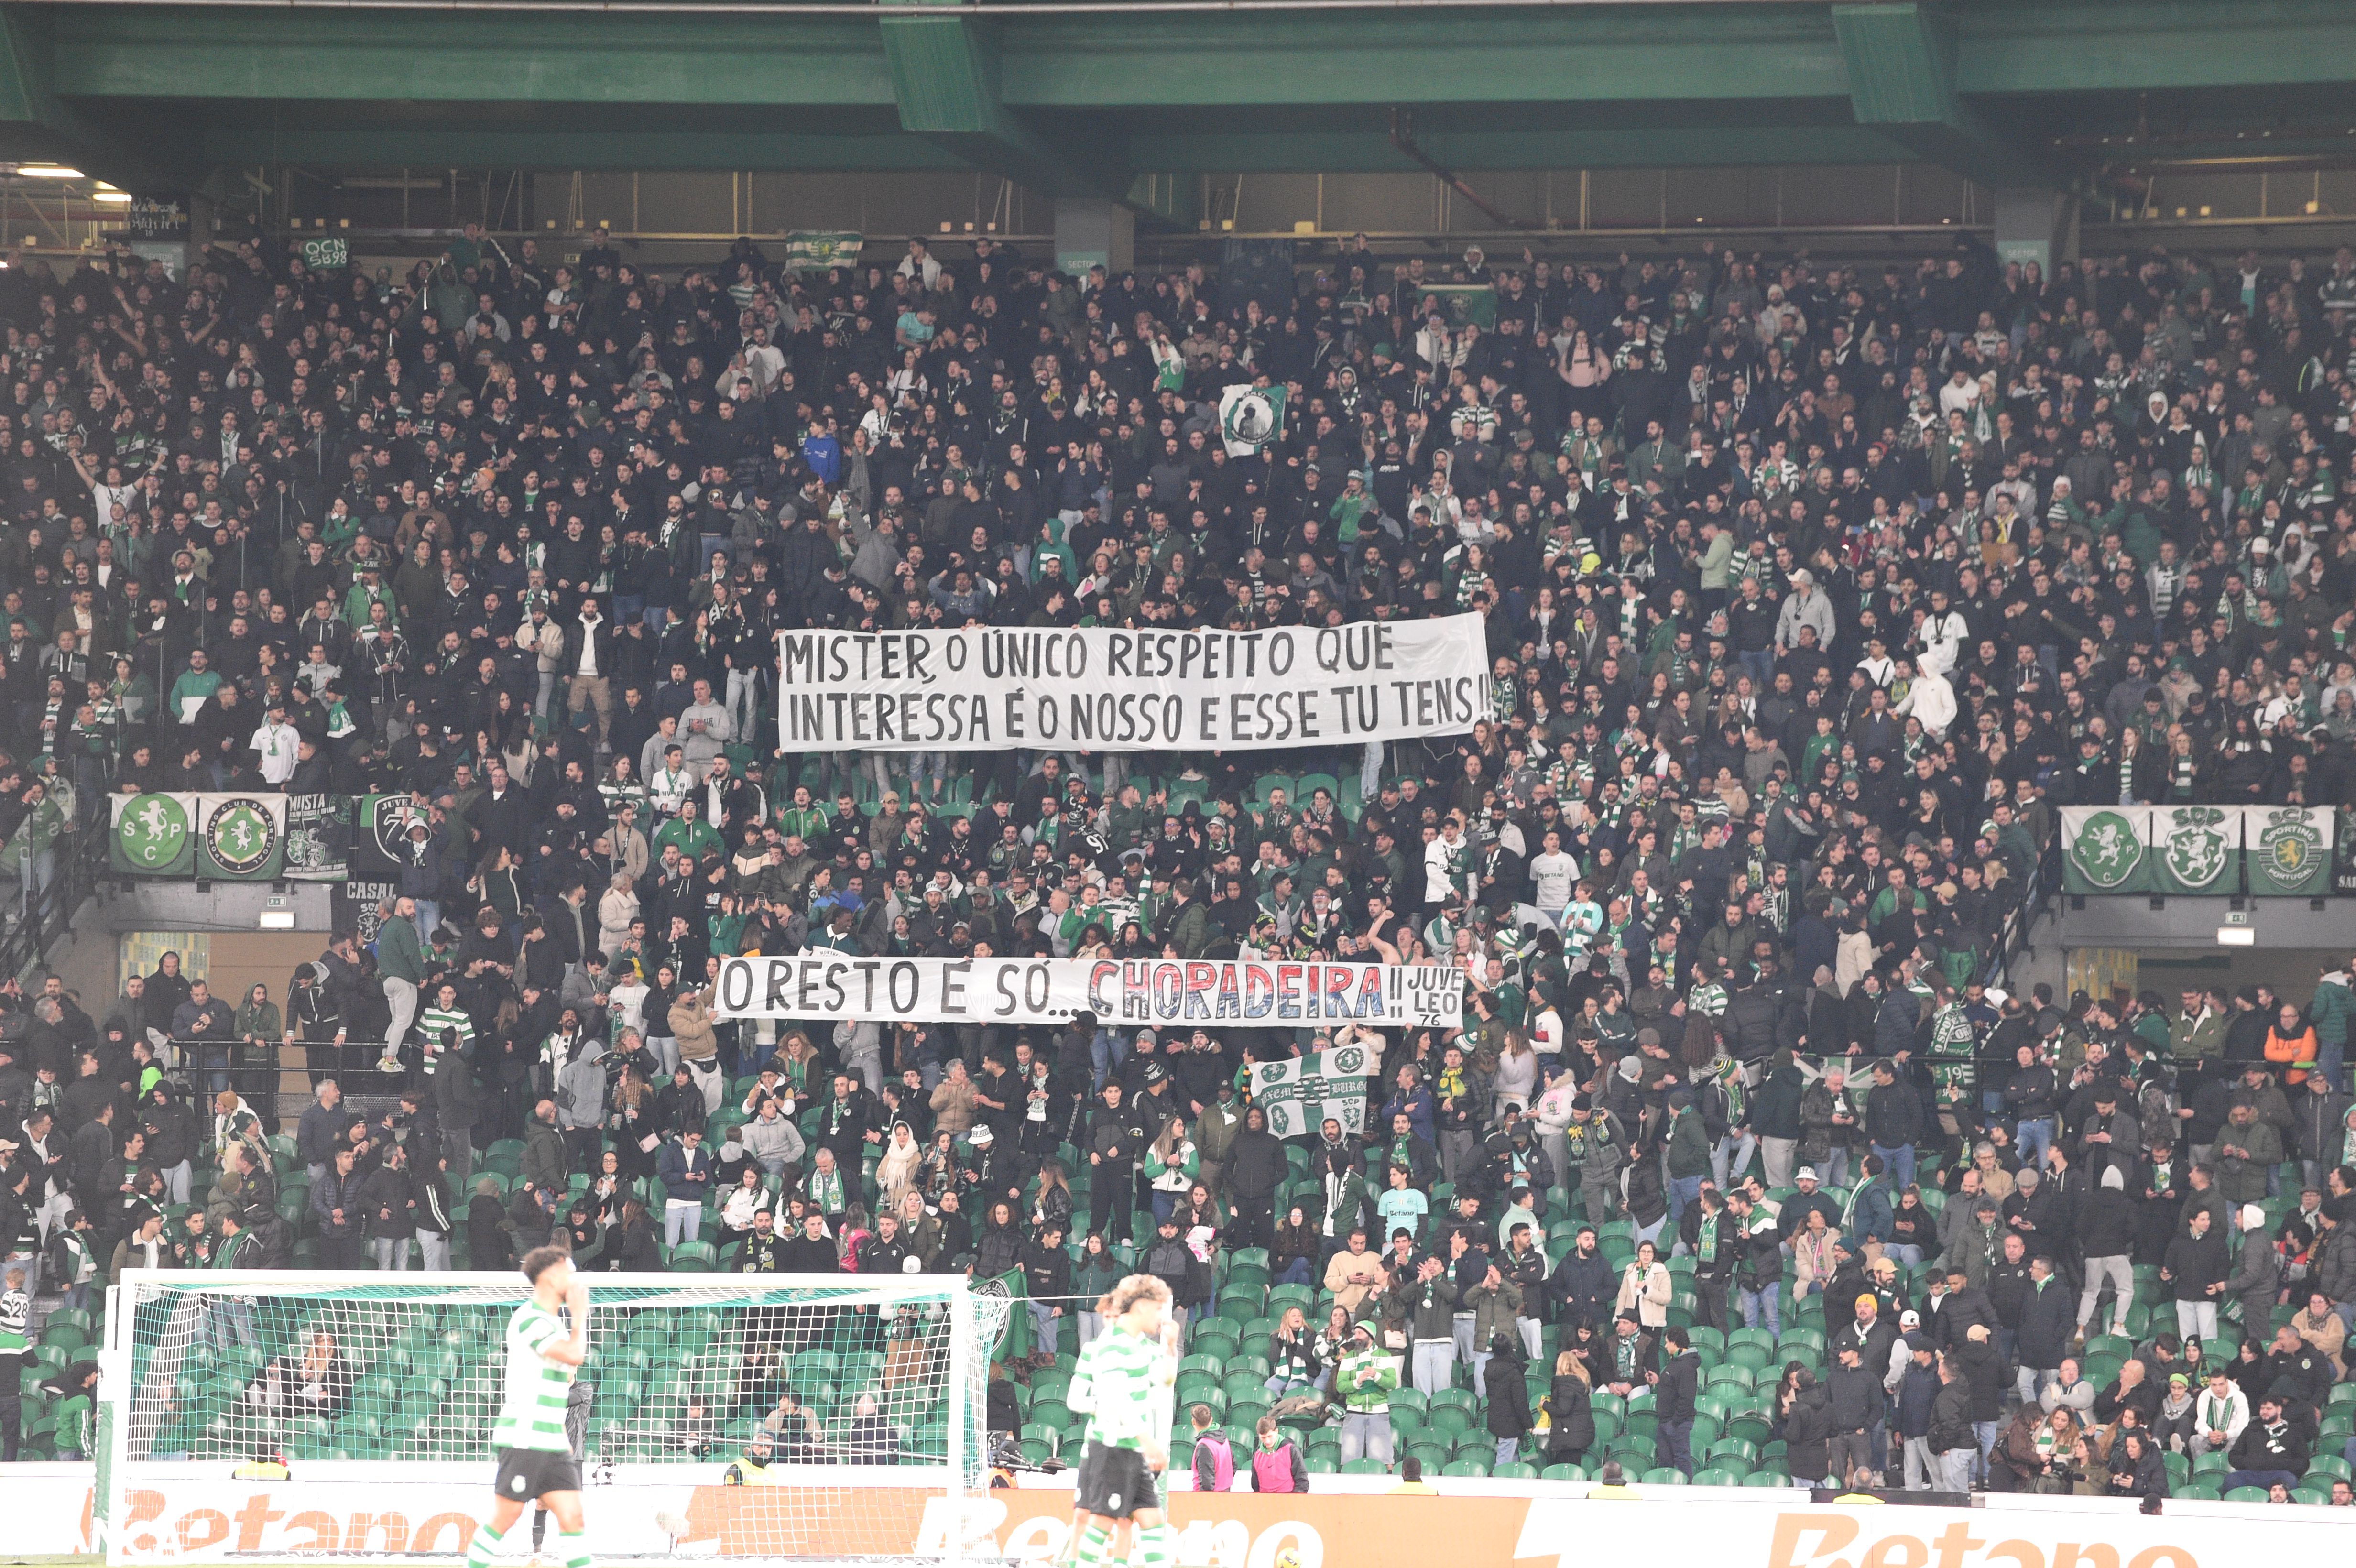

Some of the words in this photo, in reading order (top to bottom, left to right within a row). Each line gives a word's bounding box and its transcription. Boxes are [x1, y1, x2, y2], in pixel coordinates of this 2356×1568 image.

[785, 634, 936, 684] MISTER,
[946, 634, 967, 672] O
[982, 629, 1088, 679] ÚNICO
[1108, 632, 1294, 678] RESPEITO
[1316, 625, 1394, 675] QUE
[790, 692, 990, 741] INTERESSA
[1005, 686, 1024, 738] É
[1038, 693, 1058, 739] O
[1070, 692, 1183, 743] NOSSO
[1200, 697, 1220, 740] E
[1231, 690, 1320, 741] ESSE
[1331, 684, 1379, 734] TU
[222, 801, 246, 812] CLUB
[252, 803, 263, 813] DE
[382, 799, 408, 810] JUVE
[2173, 807, 2225, 827] SCP
[2268, 806, 2315, 825] SCP
[124, 822, 136, 837] S
[170, 823, 182, 838] P
[208, 814, 224, 863] SPORTING
[2264, 825, 2316, 843] SPORTING
[254, 814, 273, 865] PORTUGAL
[144, 845, 157, 860] C
[2268, 868, 2314, 881] PORTUGAL
[347, 882, 397, 899] CASAL
[722, 960, 753, 1011] O
[765, 960, 919, 1013] RESTO
[1407, 967, 1462, 991] JUVE
[1415, 991, 1457, 1014] LEO
[1419, 1014, 1440, 1026] 76
[12, 1302, 27, 1318] 28
[1352, 1358, 1380, 1368] JVE
